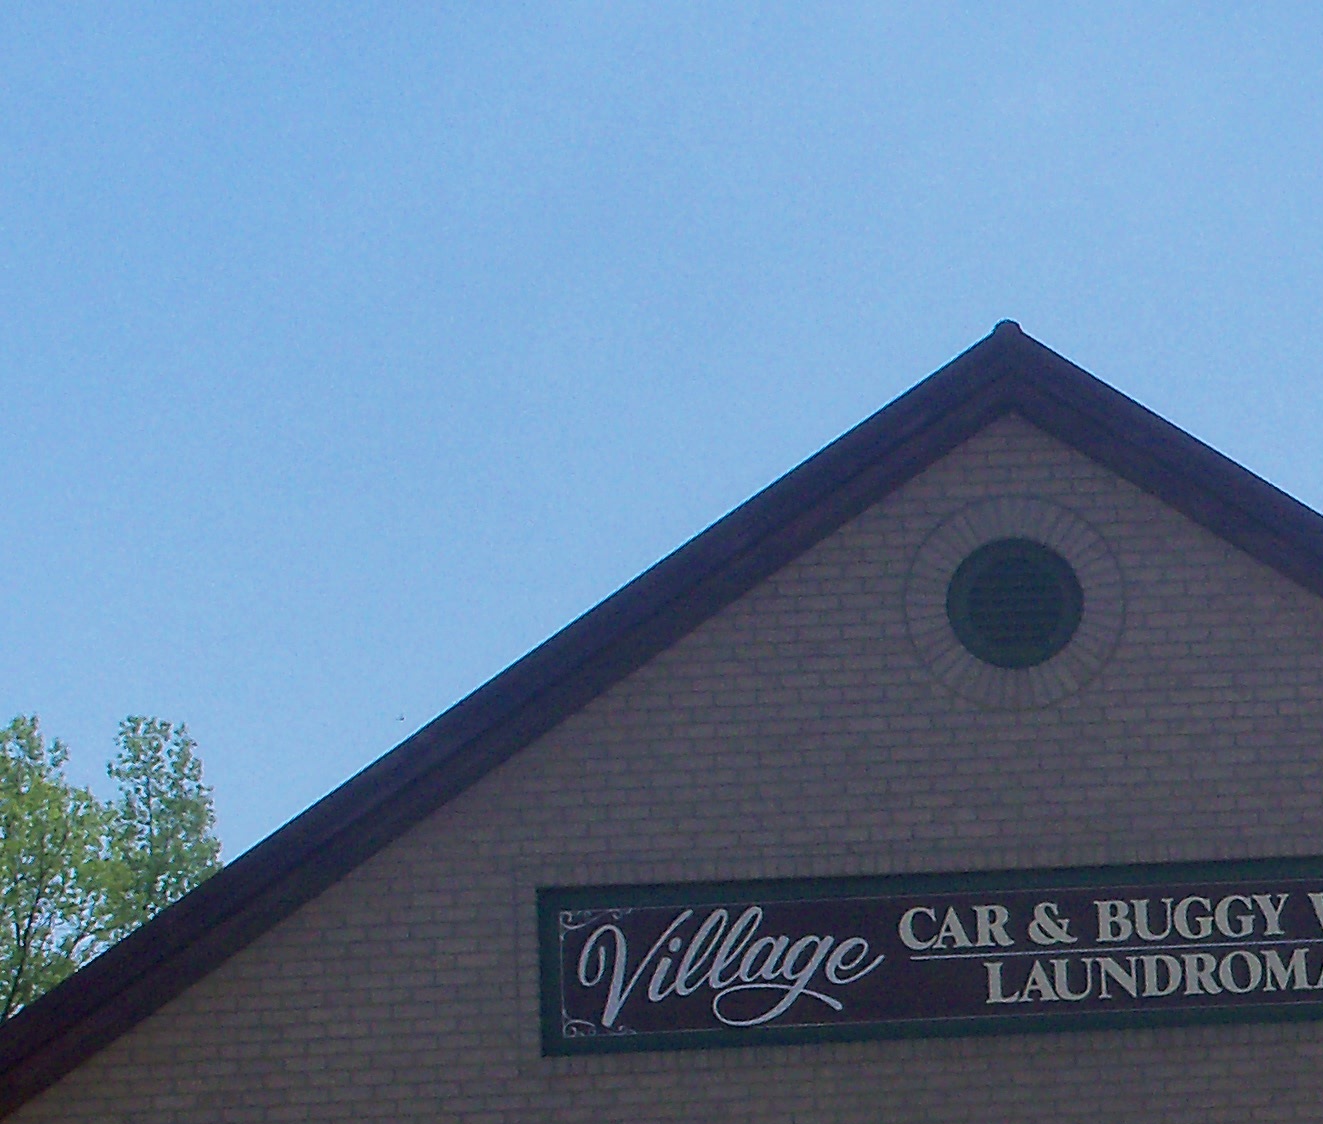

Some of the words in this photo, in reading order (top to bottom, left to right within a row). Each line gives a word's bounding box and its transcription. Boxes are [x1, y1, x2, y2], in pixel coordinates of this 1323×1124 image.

[578, 905, 886, 1028] Village
[898, 904, 1015, 951] CAR
[1028, 901, 1078, 946] &
[1093, 893, 1290, 943] BUGGY
